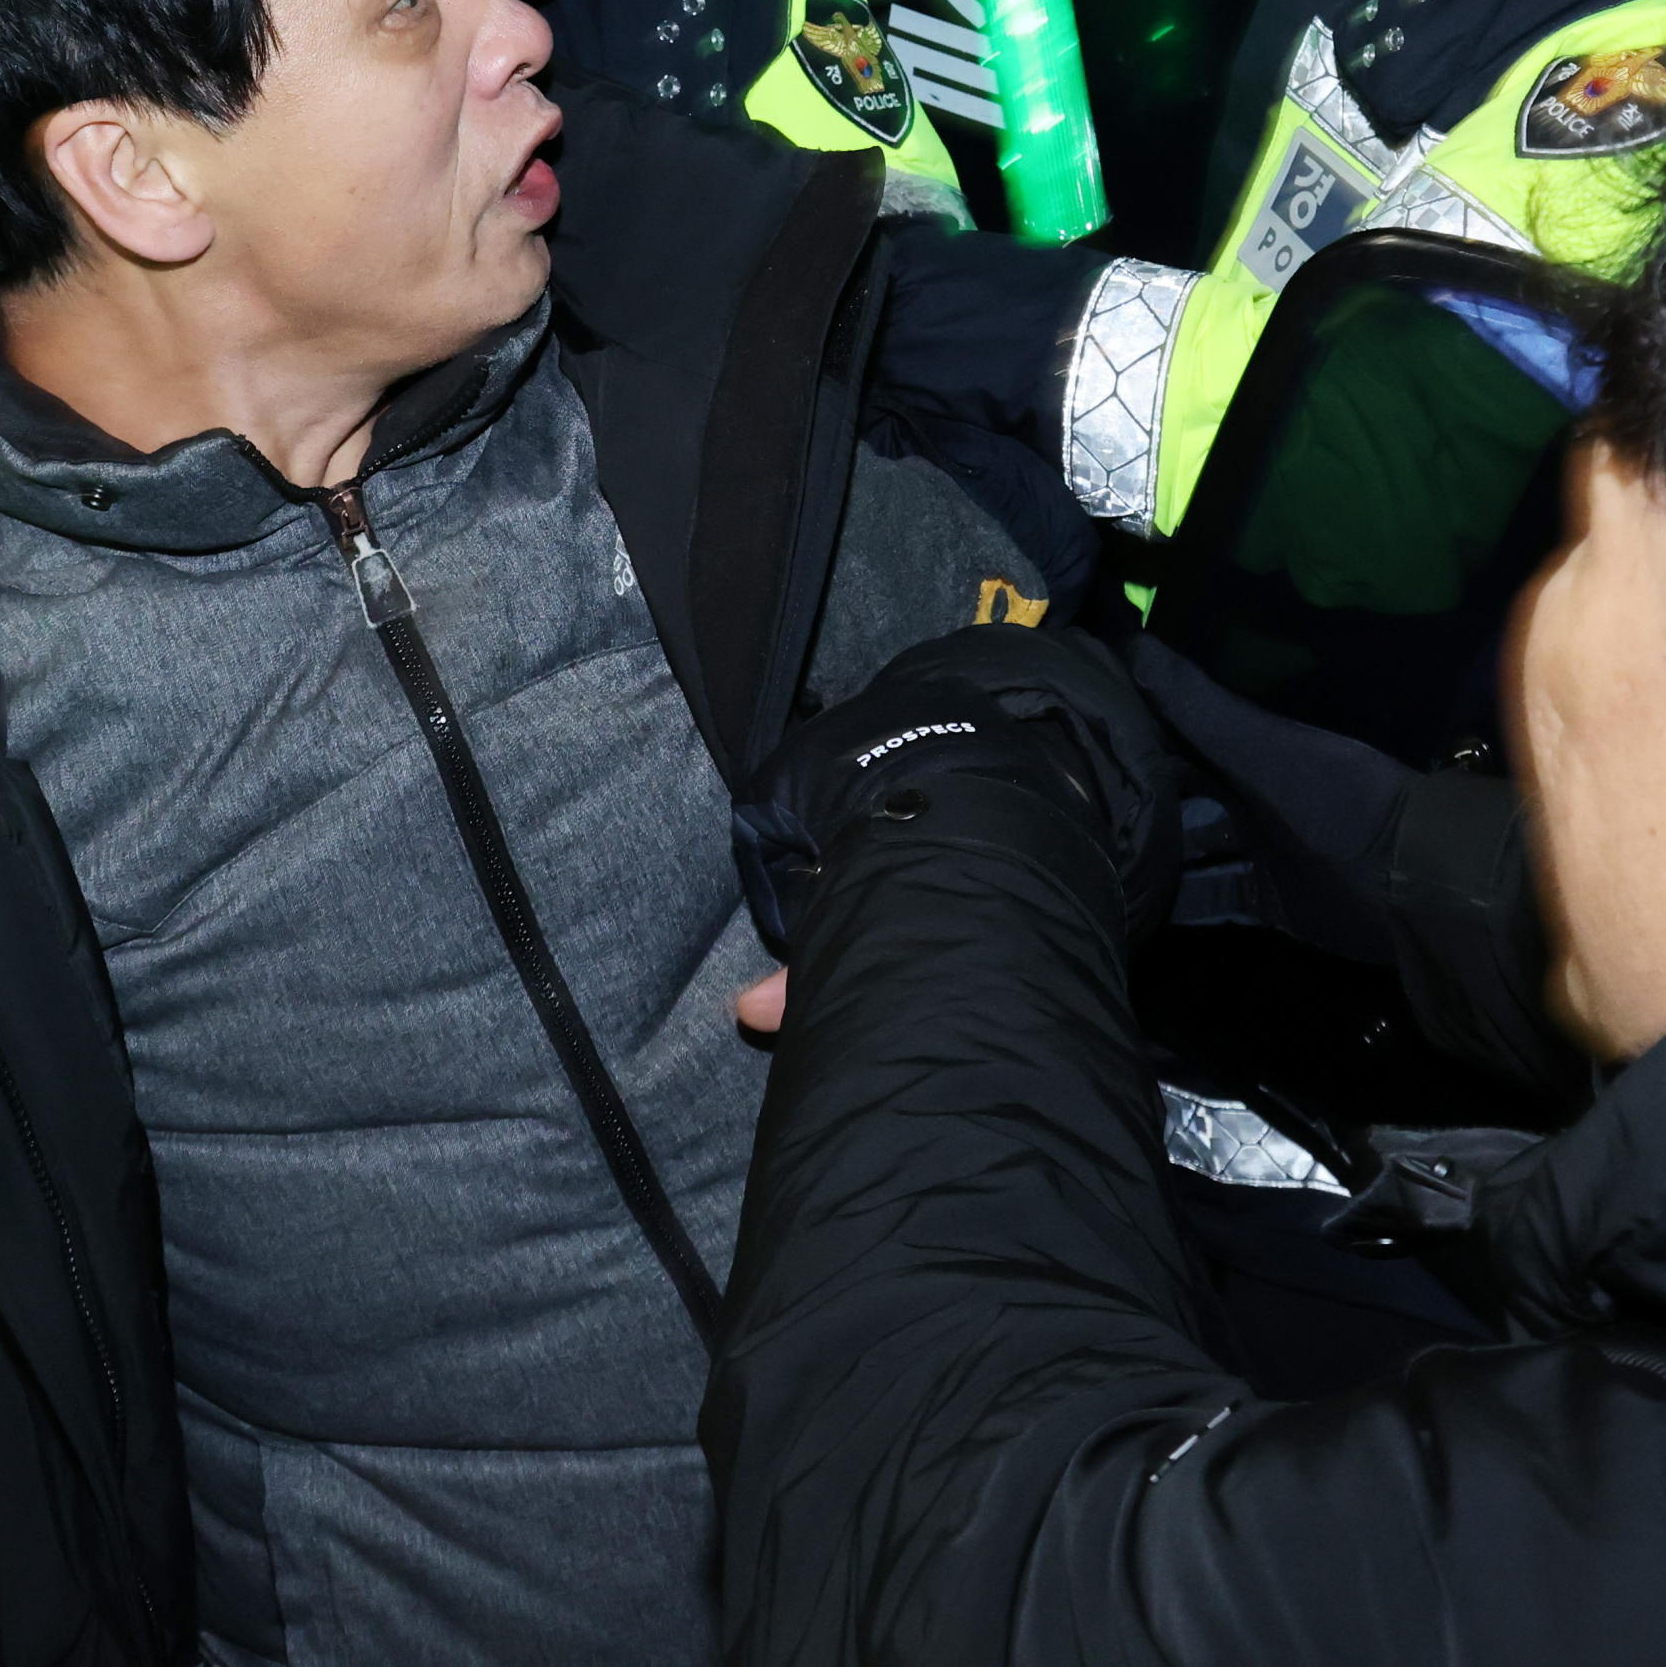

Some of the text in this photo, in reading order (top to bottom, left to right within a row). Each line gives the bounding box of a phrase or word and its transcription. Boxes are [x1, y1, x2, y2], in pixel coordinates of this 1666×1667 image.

[853, 92, 902, 112] POLICE
[1539, 96, 1596, 139] POLICE
[1288, 154, 1337, 230] 경
[1257, 226, 1307, 273] PO
[856, 722, 977, 768] PROSPECS
